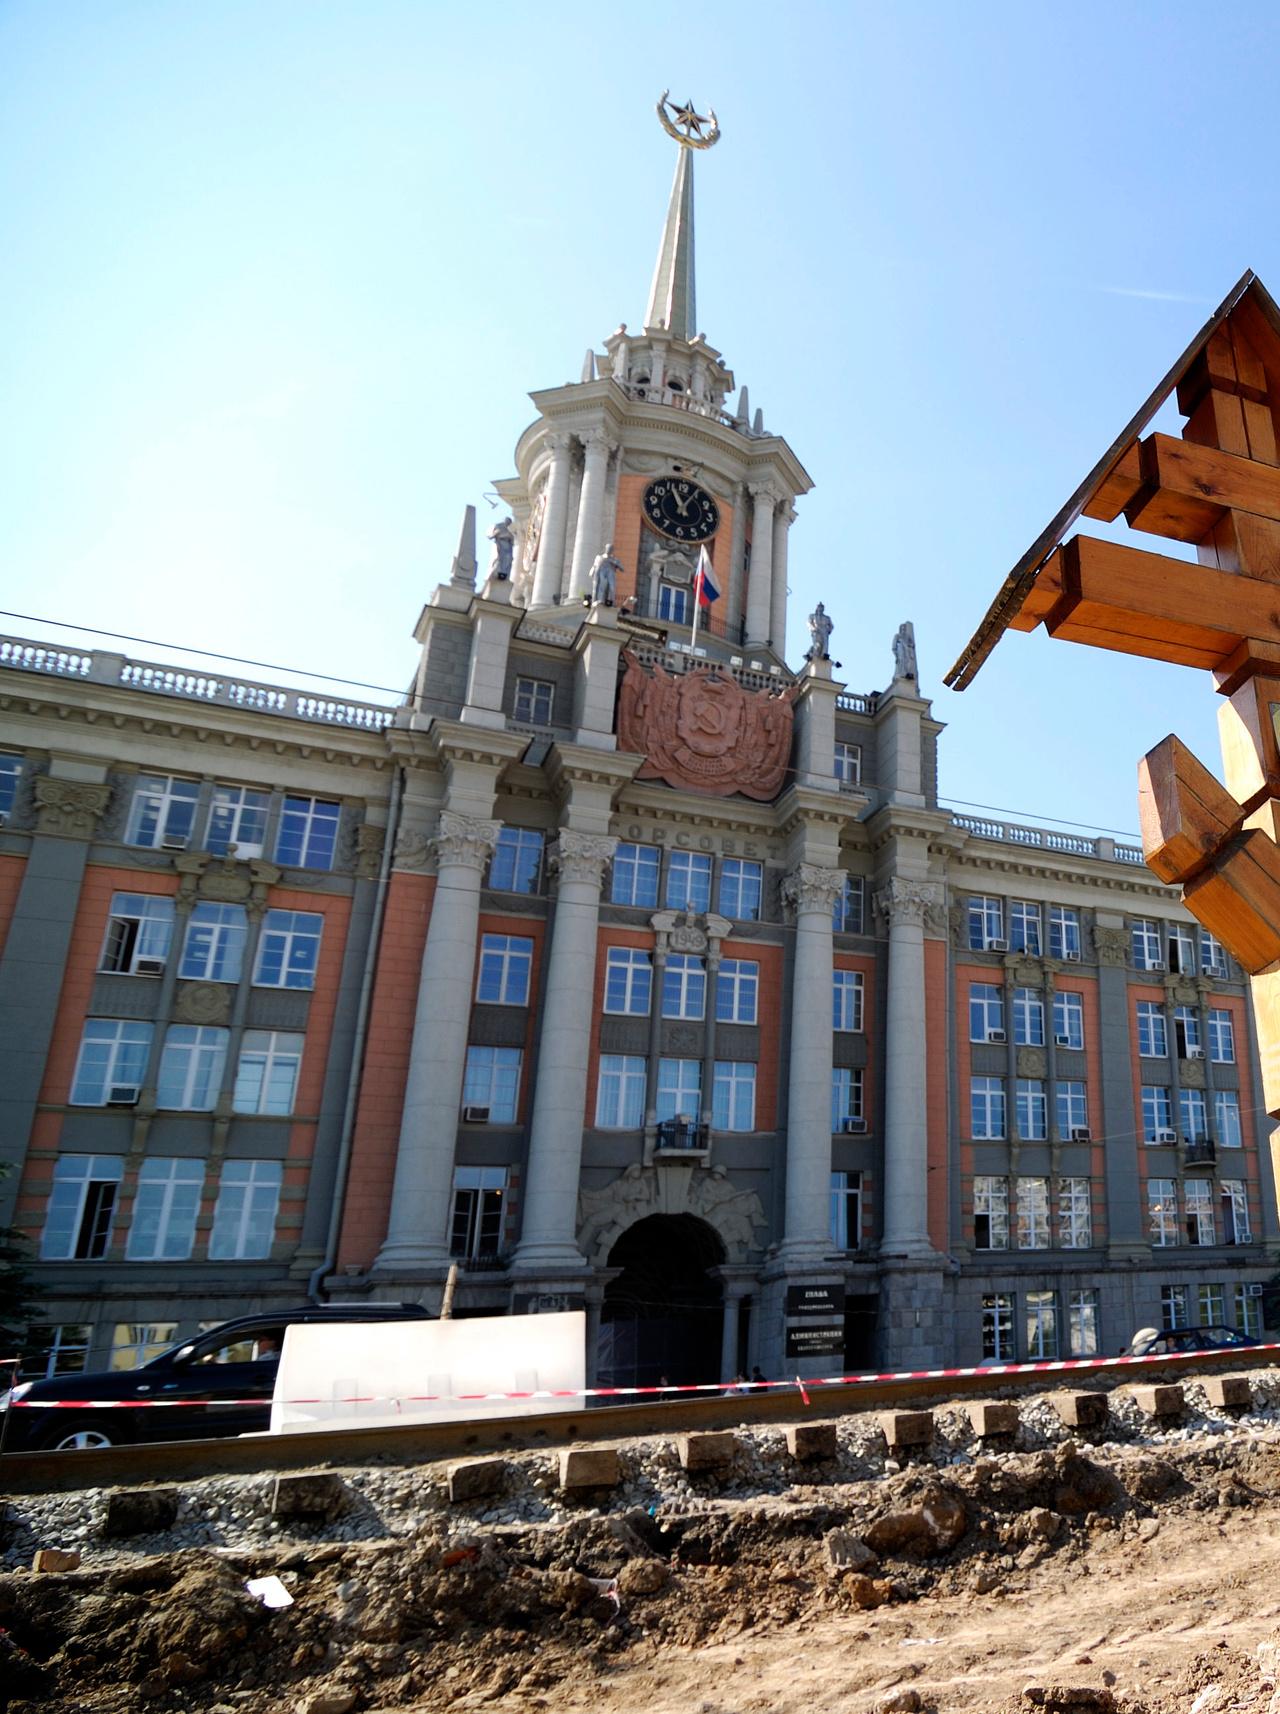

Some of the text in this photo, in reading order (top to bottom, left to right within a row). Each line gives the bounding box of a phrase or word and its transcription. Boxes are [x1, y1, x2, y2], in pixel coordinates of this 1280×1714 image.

[655, 485, 665, 496] 10
[679, 483, 689, 493] 12
[650, 495, 658, 505] 9
[702, 500, 710, 510] 2
[652, 508, 660, 518] 8
[706, 513, 713, 522] 3
[663, 519, 670, 528] 7
[700, 523, 707, 532] 4
[676, 527, 684, 536] 6
[690, 527, 698, 537] 5
